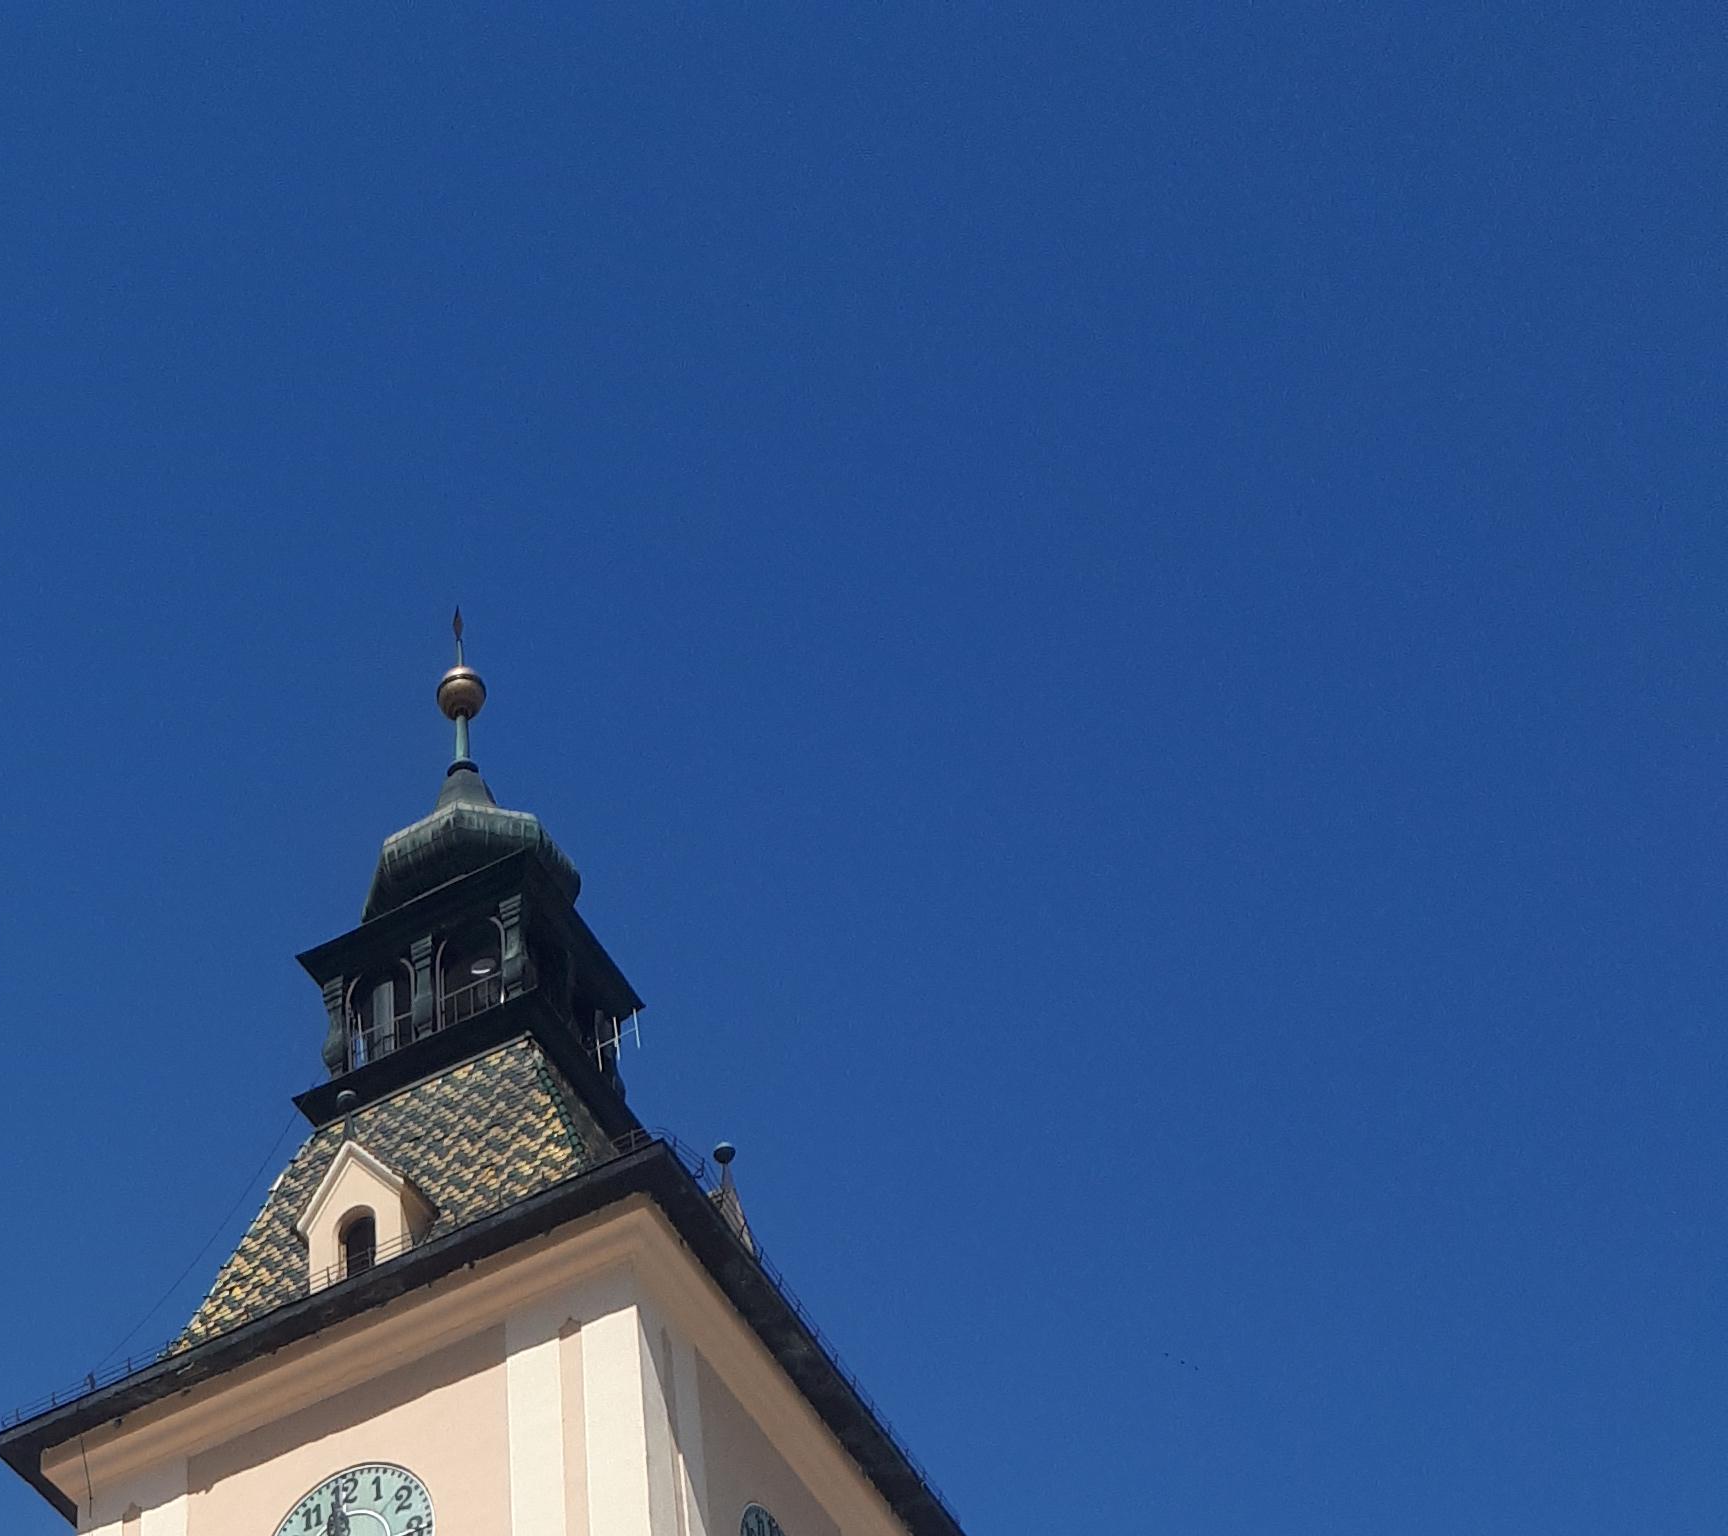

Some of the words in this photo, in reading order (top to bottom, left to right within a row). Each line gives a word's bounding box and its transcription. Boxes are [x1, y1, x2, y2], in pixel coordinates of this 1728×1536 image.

[371, 1476, 384, 1501] 1
[395, 1485, 413, 1514] 2
[302, 1503, 323, 1532] 11
